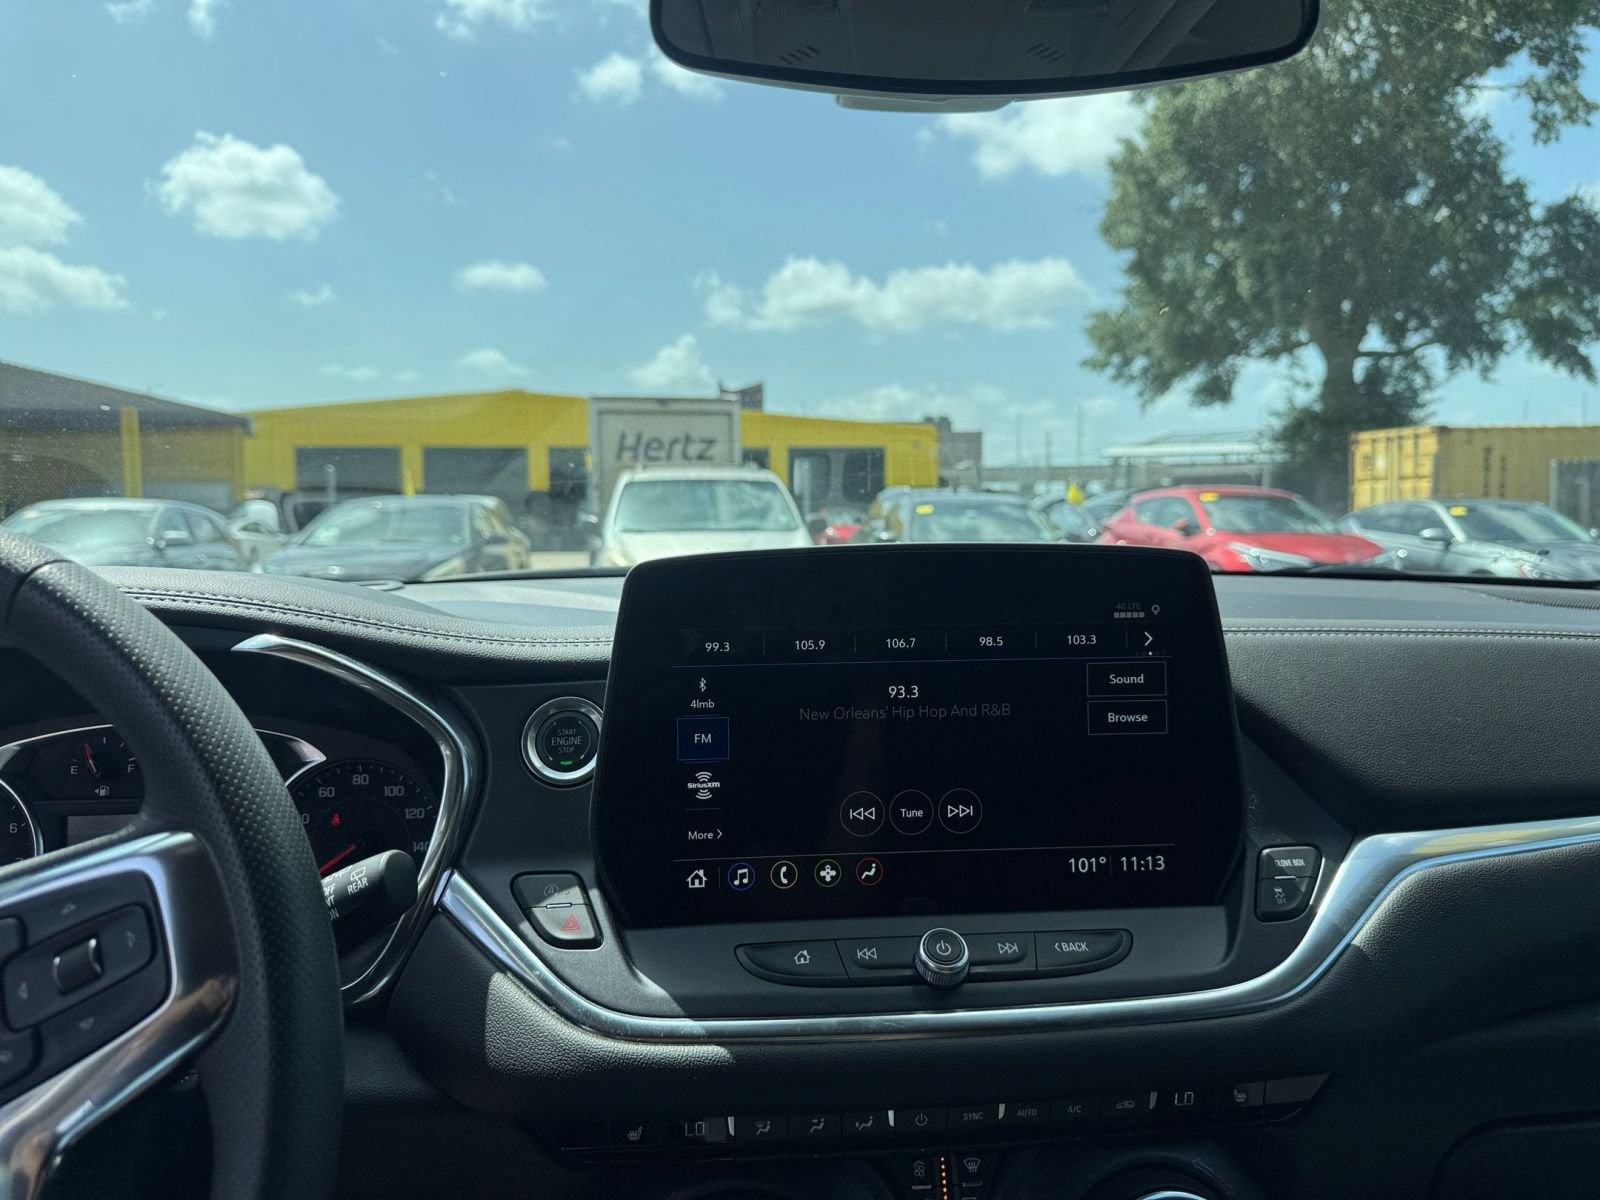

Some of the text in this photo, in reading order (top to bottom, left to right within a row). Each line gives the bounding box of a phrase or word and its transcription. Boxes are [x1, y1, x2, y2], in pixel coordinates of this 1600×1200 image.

[615, 430, 717, 462] Hertz
[886, 637, 916, 649] 106.7
[979, 636, 1003, 647] 98.5
[1067, 634, 1097, 645] 103.3
[705, 641, 730, 653] 99.3
[795, 640, 826, 651] 105.9
[1109, 673, 1145, 684] Sound
[888, 685, 919, 699] 93.3
[799, 708, 830, 721] New
[892, 705, 915, 722] Hip
[919, 704, 947, 720] Hop
[950, 704, 977, 717] And
[981, 703, 1011, 717] R&B
[1107, 712, 1149, 723] Browse
[558, 728, 576, 736] START
[551, 735, 582, 746] ENGINE
[694, 733, 712, 744] FM
[558, 746, 575, 754] STOP
[70, 765, 79, 775] E
[127, 764, 136, 773] F
[352, 774, 369, 785] 80
[318, 786, 336, 798] 60
[384, 785, 405, 797] 100
[404, 807, 425, 819] 120
[900, 808, 924, 818] Tune
[9, 822, 18, 834] 6
[688, 831, 714, 840] More
[1120, 855, 1165, 871] 11:13
[347, 876, 369, 895] REAR
[1061, 941, 1089, 952] BACK
[1016, 1108, 1037, 1117] AUTO
[1067, 1104, 1082, 1113] A/C
[963, 1111, 984, 1121] SYNC
